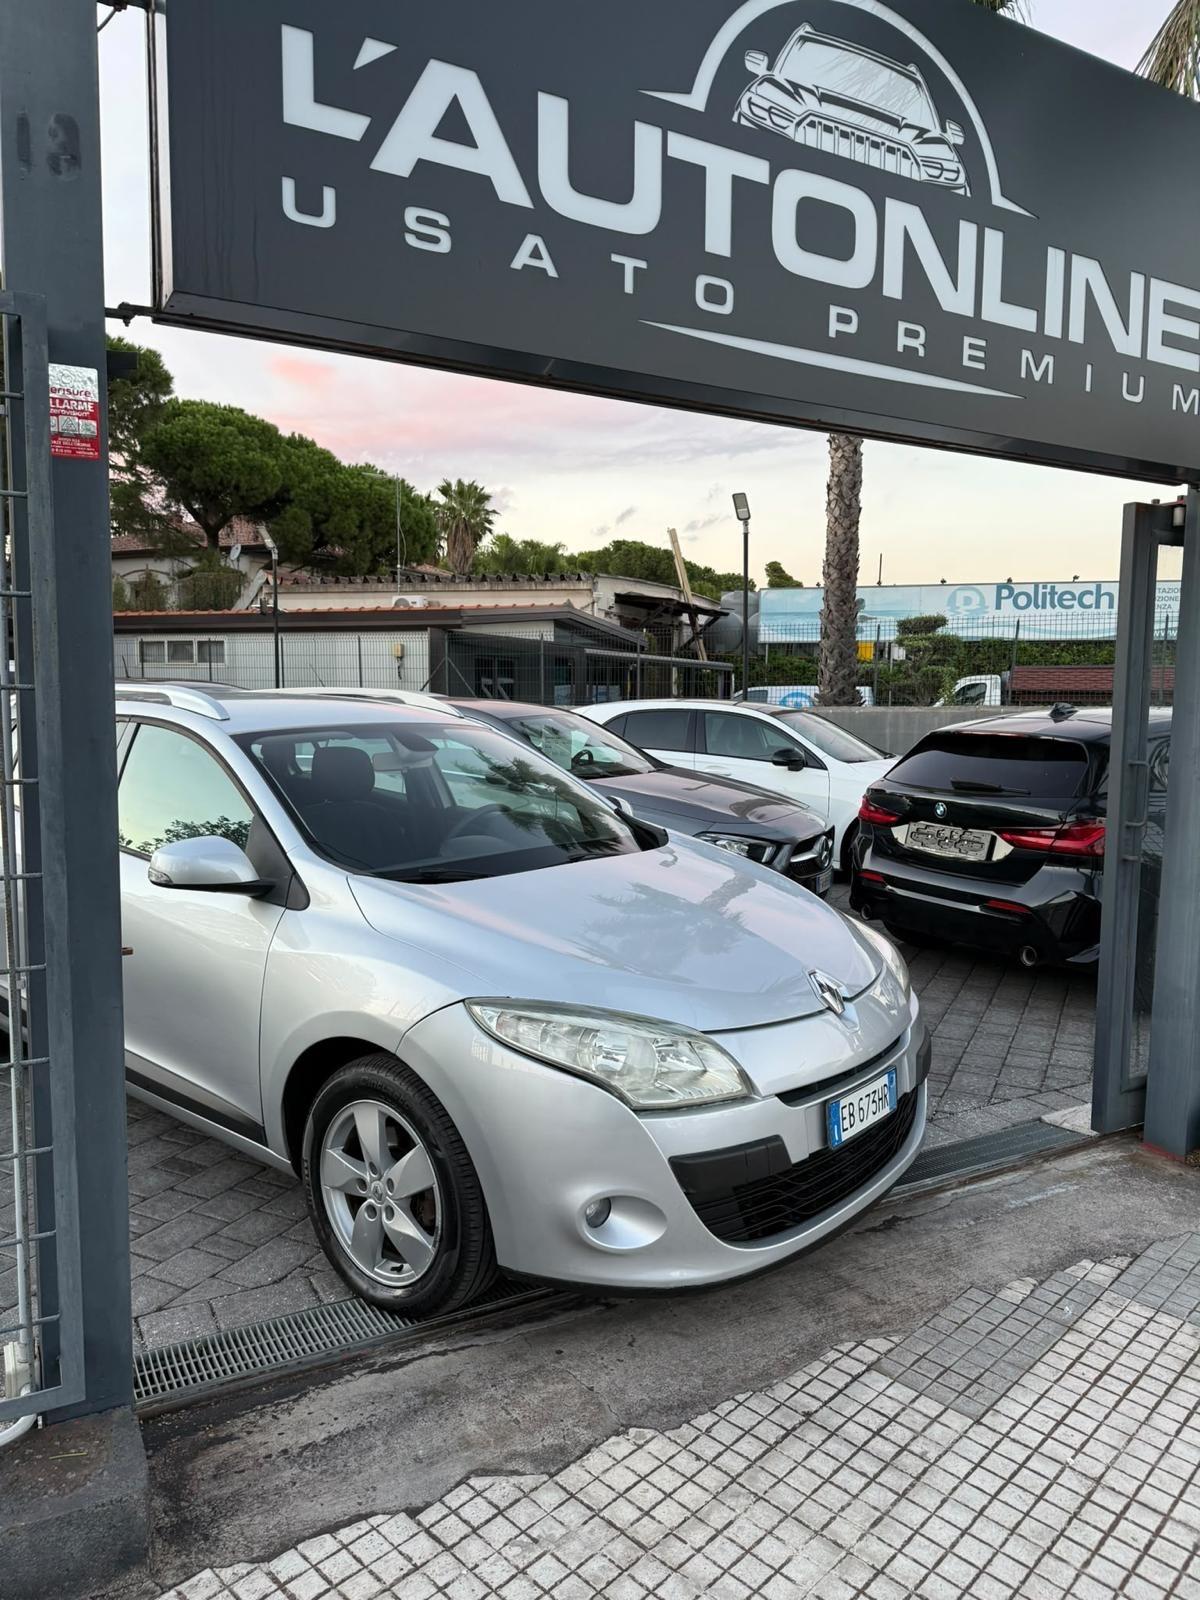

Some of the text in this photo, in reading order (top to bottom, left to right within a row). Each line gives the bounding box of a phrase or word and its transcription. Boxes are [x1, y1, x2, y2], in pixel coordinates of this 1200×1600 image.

[282, 176, 1200, 416] USATO PREMIUM
[995, 583, 1115, 611] Politech
[841, 1102, 856, 1132] EB
[858, 1083, 889, 1123] 673HR
